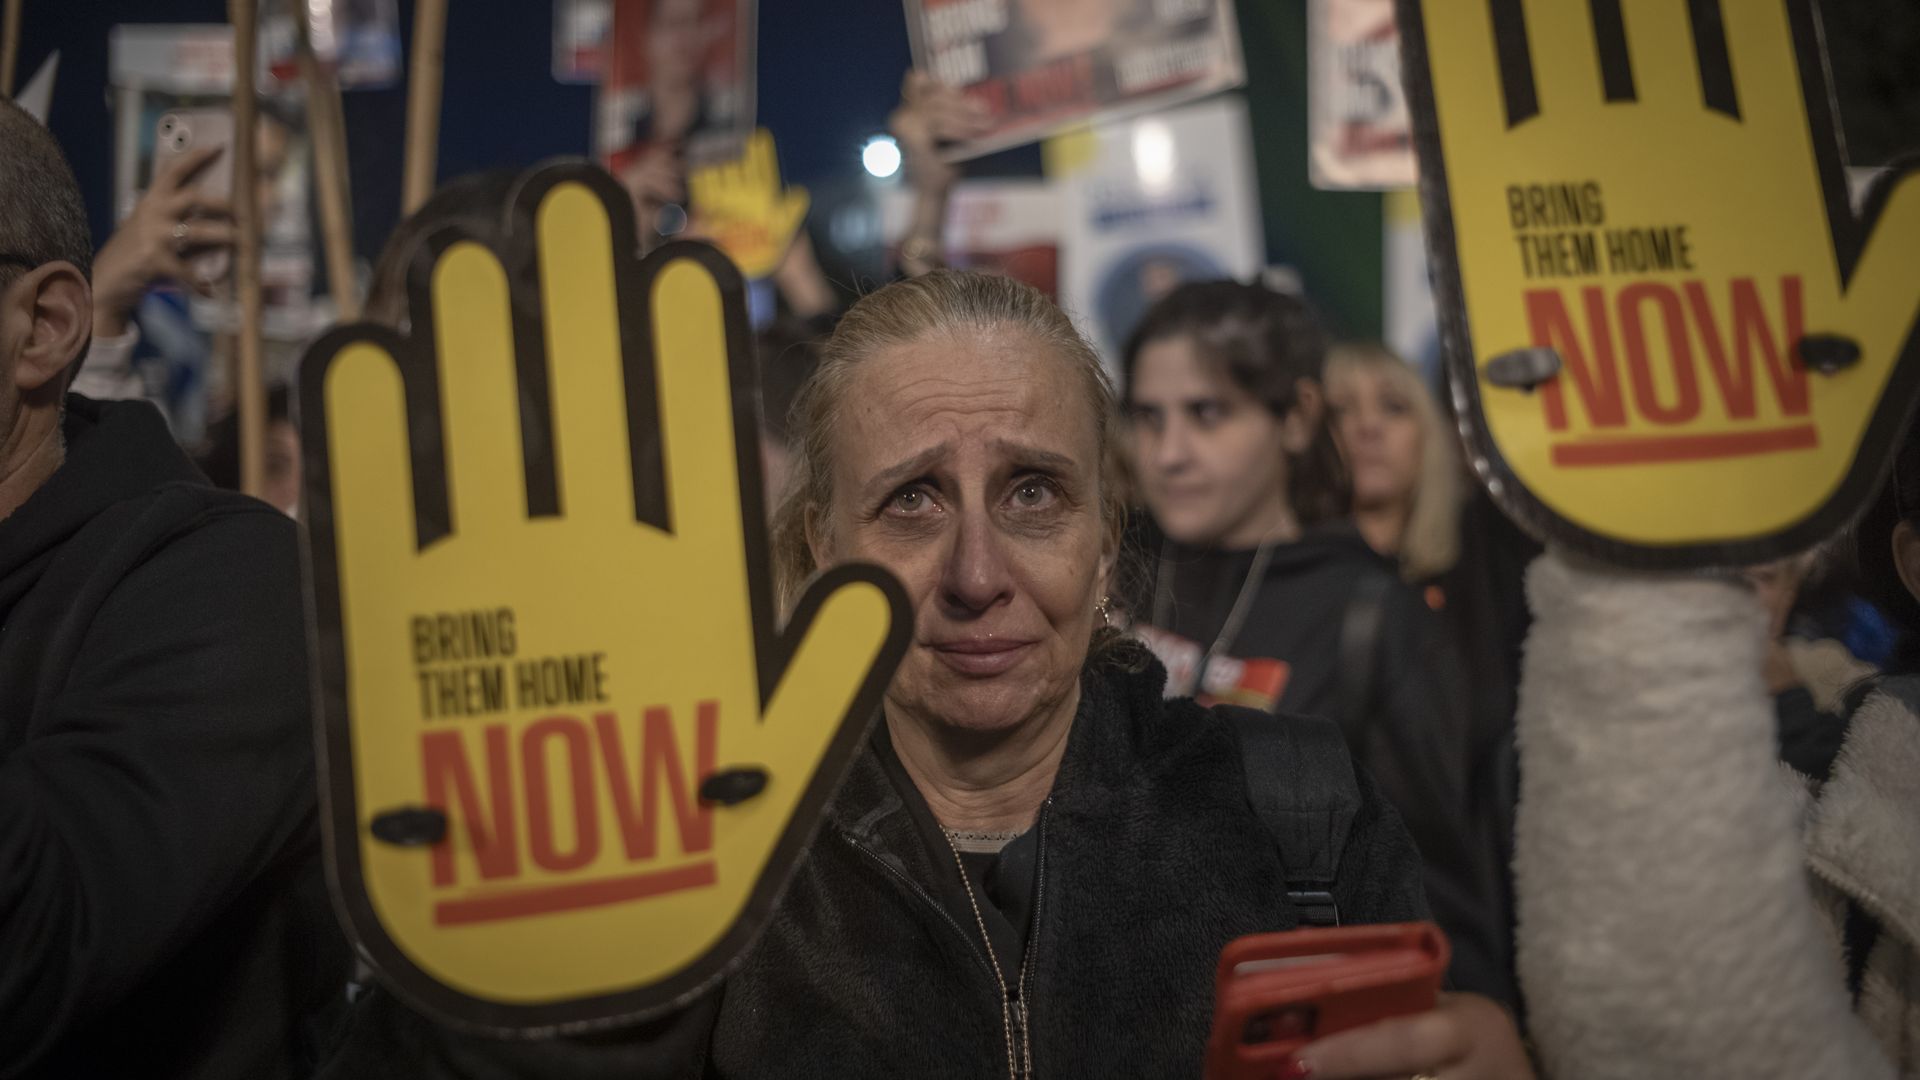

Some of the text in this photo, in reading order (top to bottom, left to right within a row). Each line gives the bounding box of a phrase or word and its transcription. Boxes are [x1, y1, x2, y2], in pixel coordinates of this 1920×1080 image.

[1506, 181, 1605, 229] BRING
[1514, 225, 1695, 279] THEM HOME
[1522, 274, 1811, 433] NOW
[410, 608, 517, 665] BRING
[417, 651, 611, 722] THEM HOME
[419, 699, 720, 889] NOW
